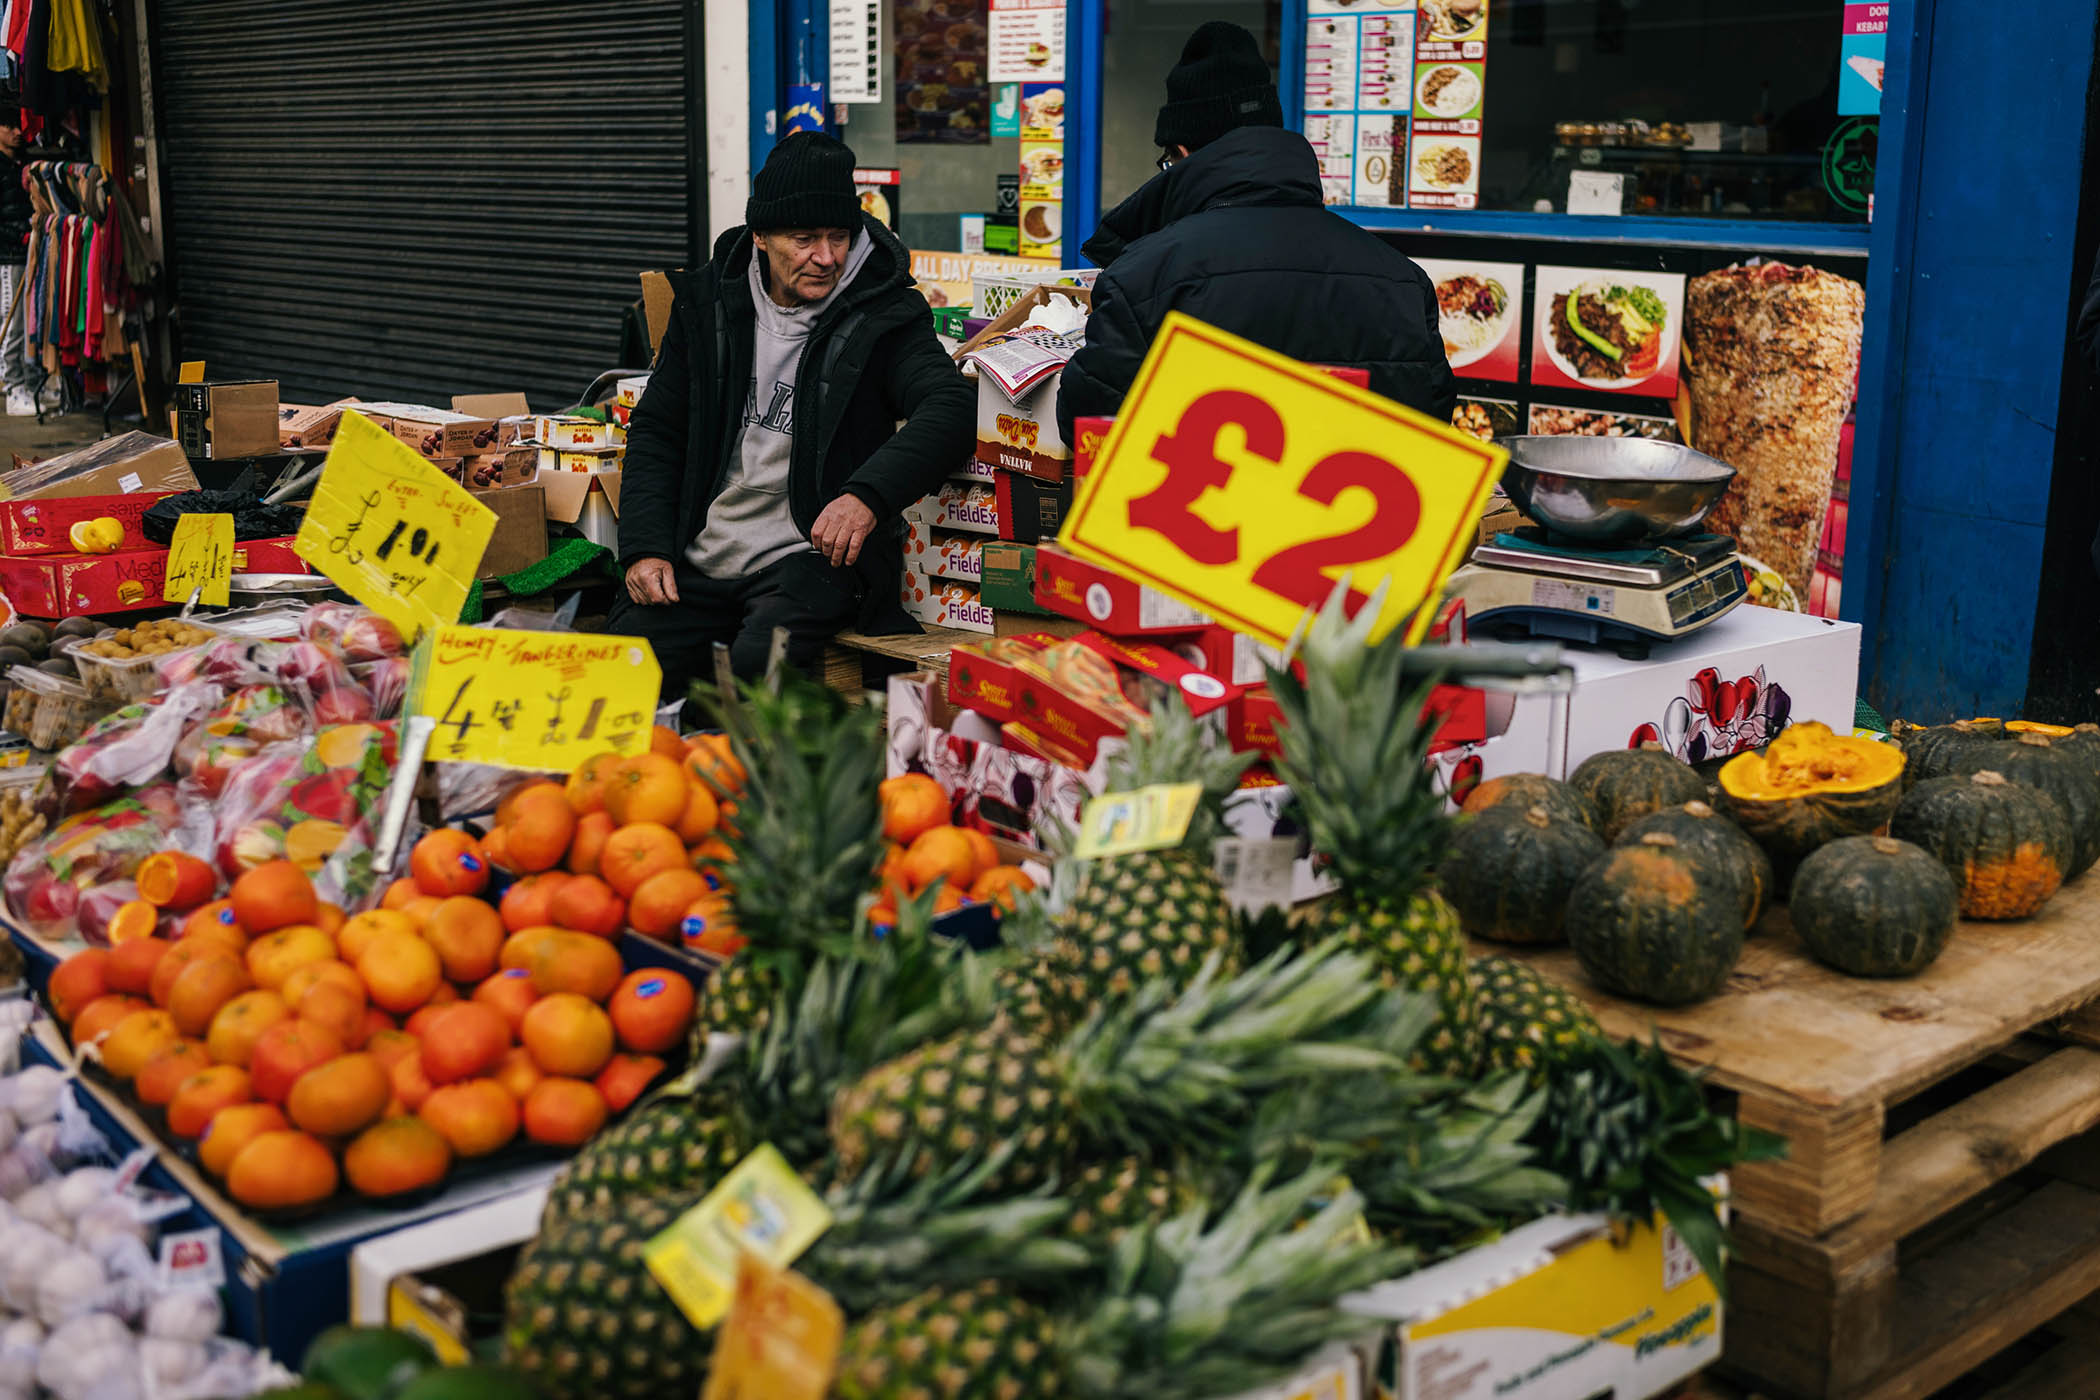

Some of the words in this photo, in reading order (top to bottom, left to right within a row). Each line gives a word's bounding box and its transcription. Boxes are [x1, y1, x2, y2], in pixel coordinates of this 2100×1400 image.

[1856, 21, 1884, 32] KEBAB
[913, 256, 938, 280] ALL
[942, 258, 968, 282] DAY
[1021, 421, 1038, 448] Sun
[999, 453, 1033, 472] MATINA
[948, 504, 997, 525] FieldEx
[1127, 388, 1422, 622] £2
[949, 554, 981, 575] Field
[439, 633, 498, 659] HONEY
[440, 675, 485, 741] 4
